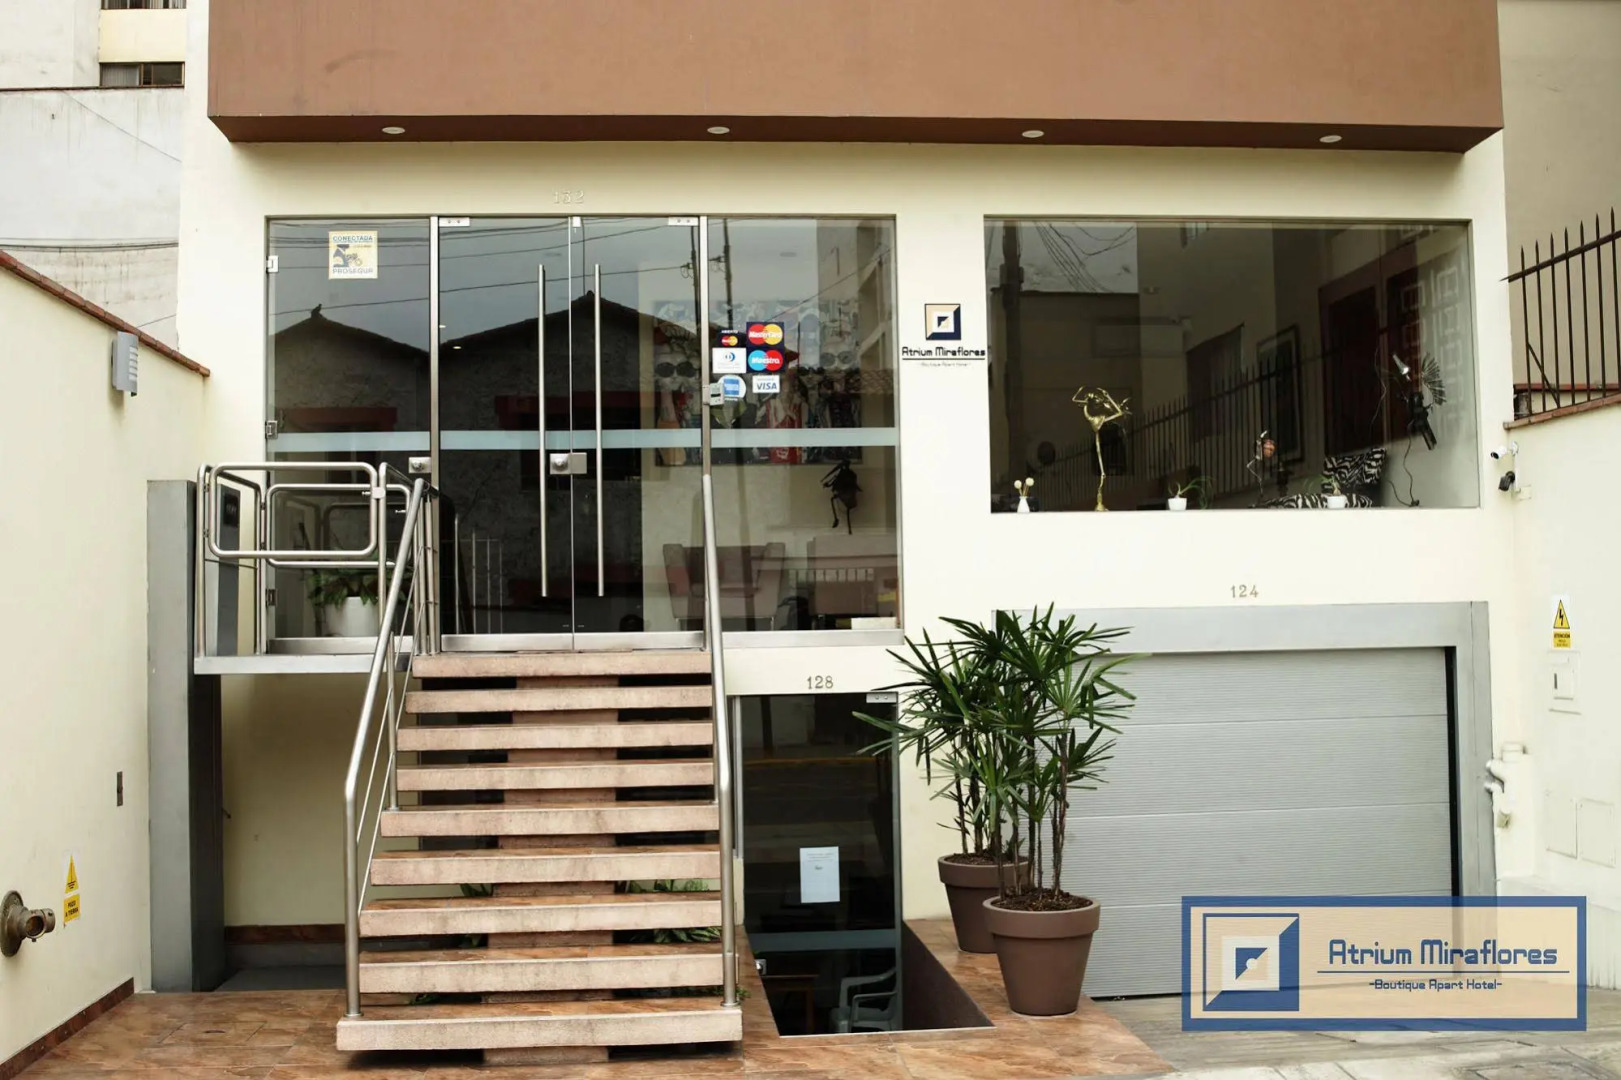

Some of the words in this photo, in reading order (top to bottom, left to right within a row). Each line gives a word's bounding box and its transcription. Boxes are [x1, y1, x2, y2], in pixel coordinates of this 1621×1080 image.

[901, 346, 932, 356] Atrium
[935, 346, 986, 356] Miraflores
[756, 382, 778, 390] VISA
[1230, 584, 1259, 598] 124
[806, 675, 834, 690] 128
